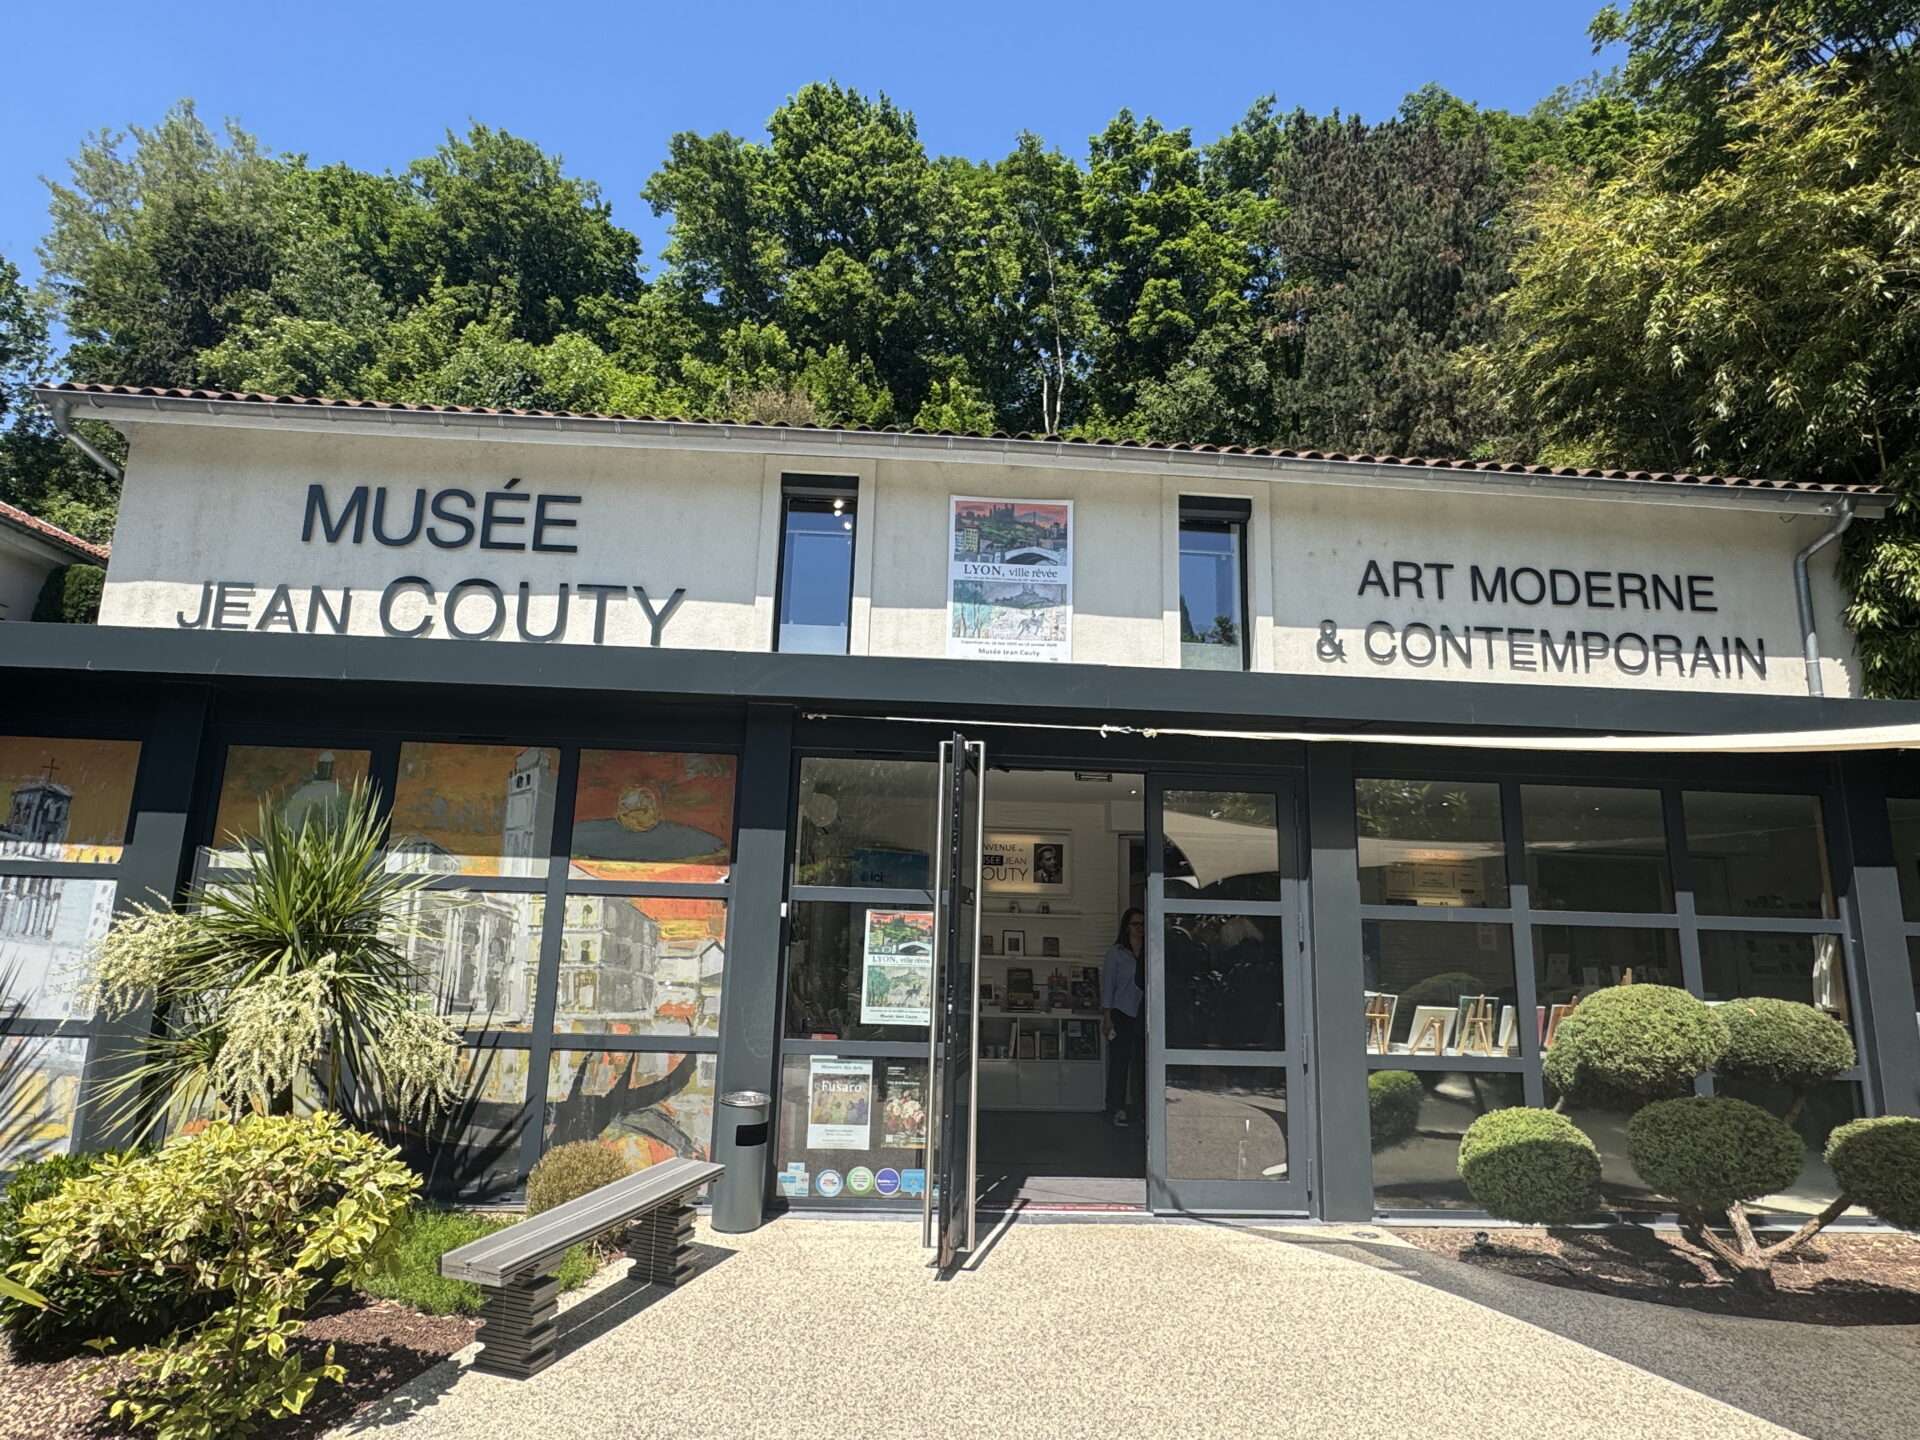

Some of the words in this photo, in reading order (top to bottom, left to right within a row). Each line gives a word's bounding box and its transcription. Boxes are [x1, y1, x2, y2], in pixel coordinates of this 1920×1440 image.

[301, 478, 582, 553] MUSÉE
[963, 563, 1005, 577] LYON,
[1009, 567, 1030, 577] ville
[1357, 560, 1454, 600] ART
[1470, 565, 1718, 612] MODERNE
[176, 580, 352, 634] JEAN
[379, 575, 687, 647] COUTY
[1316, 619, 1347, 662] &
[1364, 620, 1767, 680] CONTEMPORAIN
[821, 1080, 862, 1093] Fusaro
